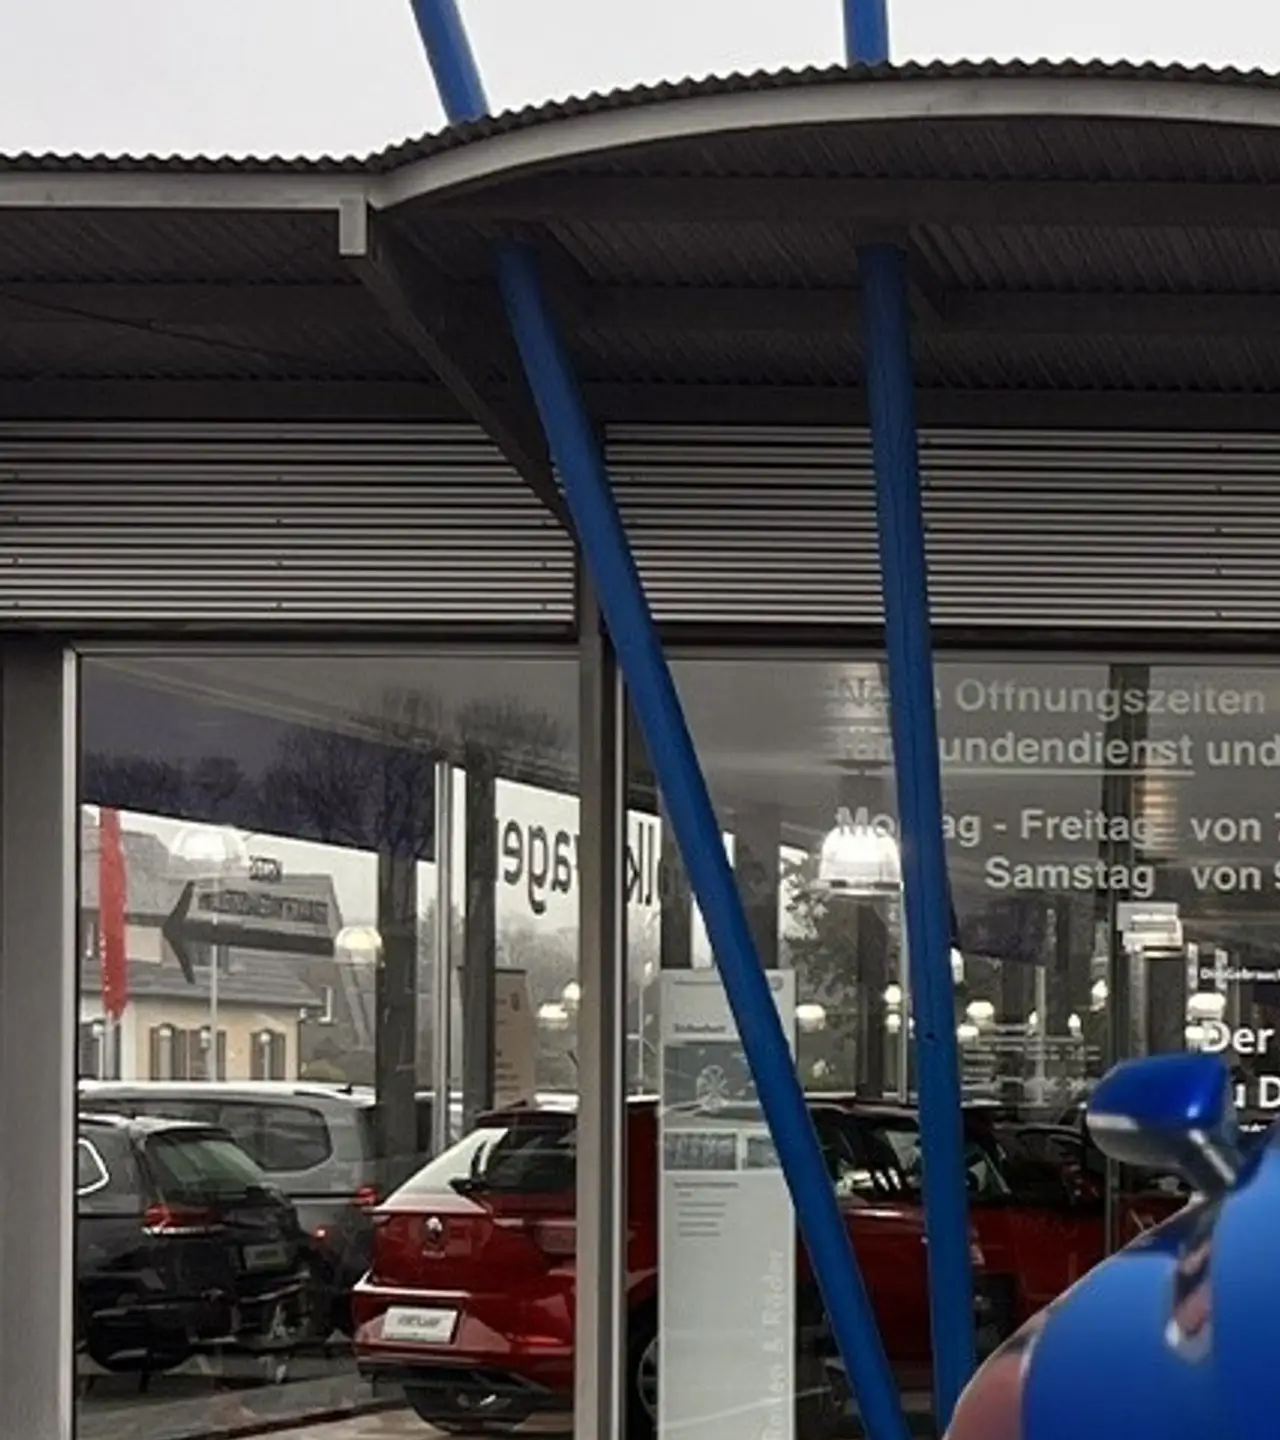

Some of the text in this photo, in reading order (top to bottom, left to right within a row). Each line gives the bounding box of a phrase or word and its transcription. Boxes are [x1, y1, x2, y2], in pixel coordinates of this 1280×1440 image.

[938, 732, 1194, 766] undendienst
[834, 806, 982, 847] Moag
[1020, 809, 1153, 848] Freitag
[1190, 817, 1262, 843] von
[984, 857, 1156, 896] Samstag
[1190, 865, 1262, 891] von
[1199, 1020, 1275, 1054] Der
